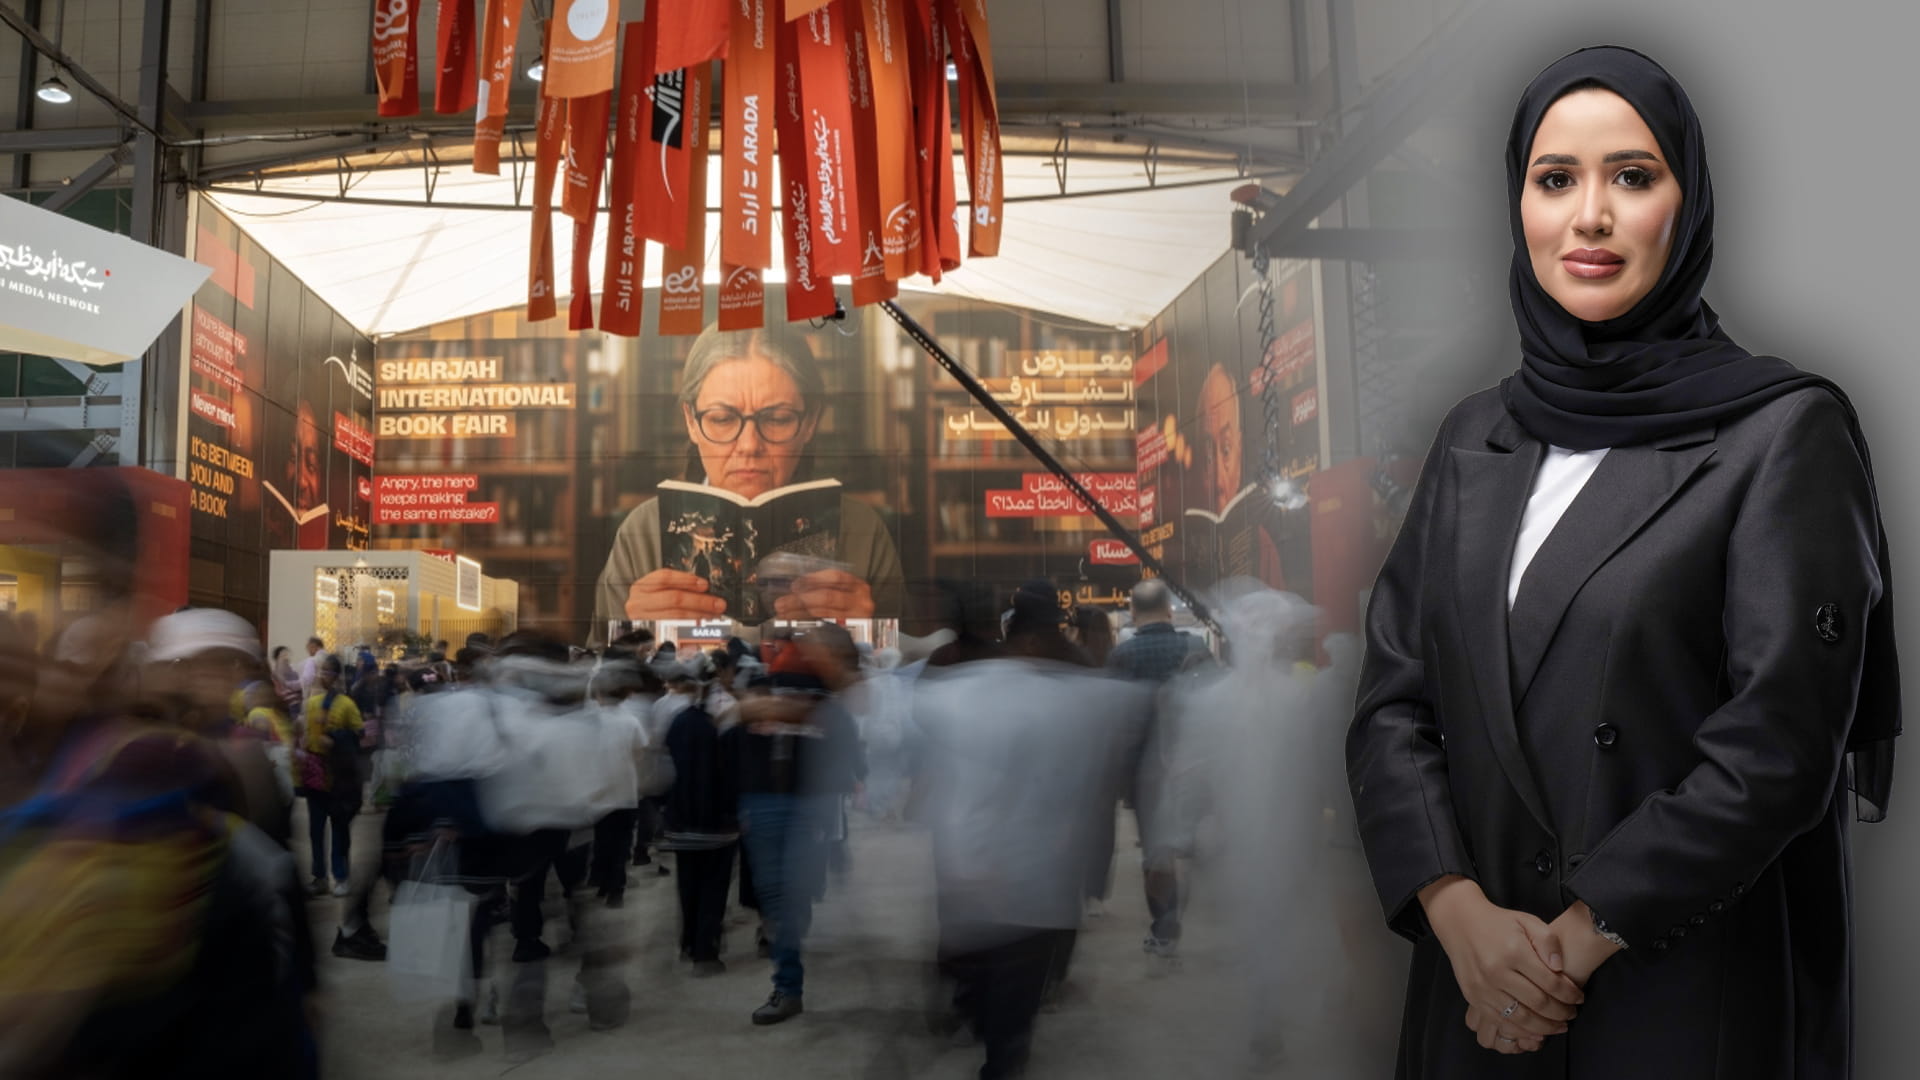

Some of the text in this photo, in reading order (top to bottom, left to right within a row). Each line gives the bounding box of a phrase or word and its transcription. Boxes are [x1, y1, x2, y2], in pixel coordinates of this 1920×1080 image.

[743, 95, 759, 164] ARADA
[8, 280, 45, 299] MEDIA
[47, 291, 101, 315] NETWORK
[380, 359, 497, 381] SHARJAH
[1022, 350, 1133, 377] معرض
[193, 393, 216, 417] Never
[380, 386, 570, 408] INTERNATIONAL
[379, 415, 508, 436] BOOK FAIR
[949, 409, 1135, 440] الدولي للكاب
[208, 443, 254, 479] BETWEEN
[190, 461, 235, 495] YOU AND
[381, 477, 420, 491] Angry,
[422, 477, 443, 489] the
[444, 477, 475, 489] hero
[1030, 475, 1065, 493] بطل
[1096, 476, 1137, 492] غاضب
[190, 489, 227, 518] A BOOK
[380, 492, 465, 506] keeps making
[1038, 495, 1072, 511] الخطأ
[1112, 495, 1138, 512] يكرر
[380, 507, 496, 520] the same mistake?
